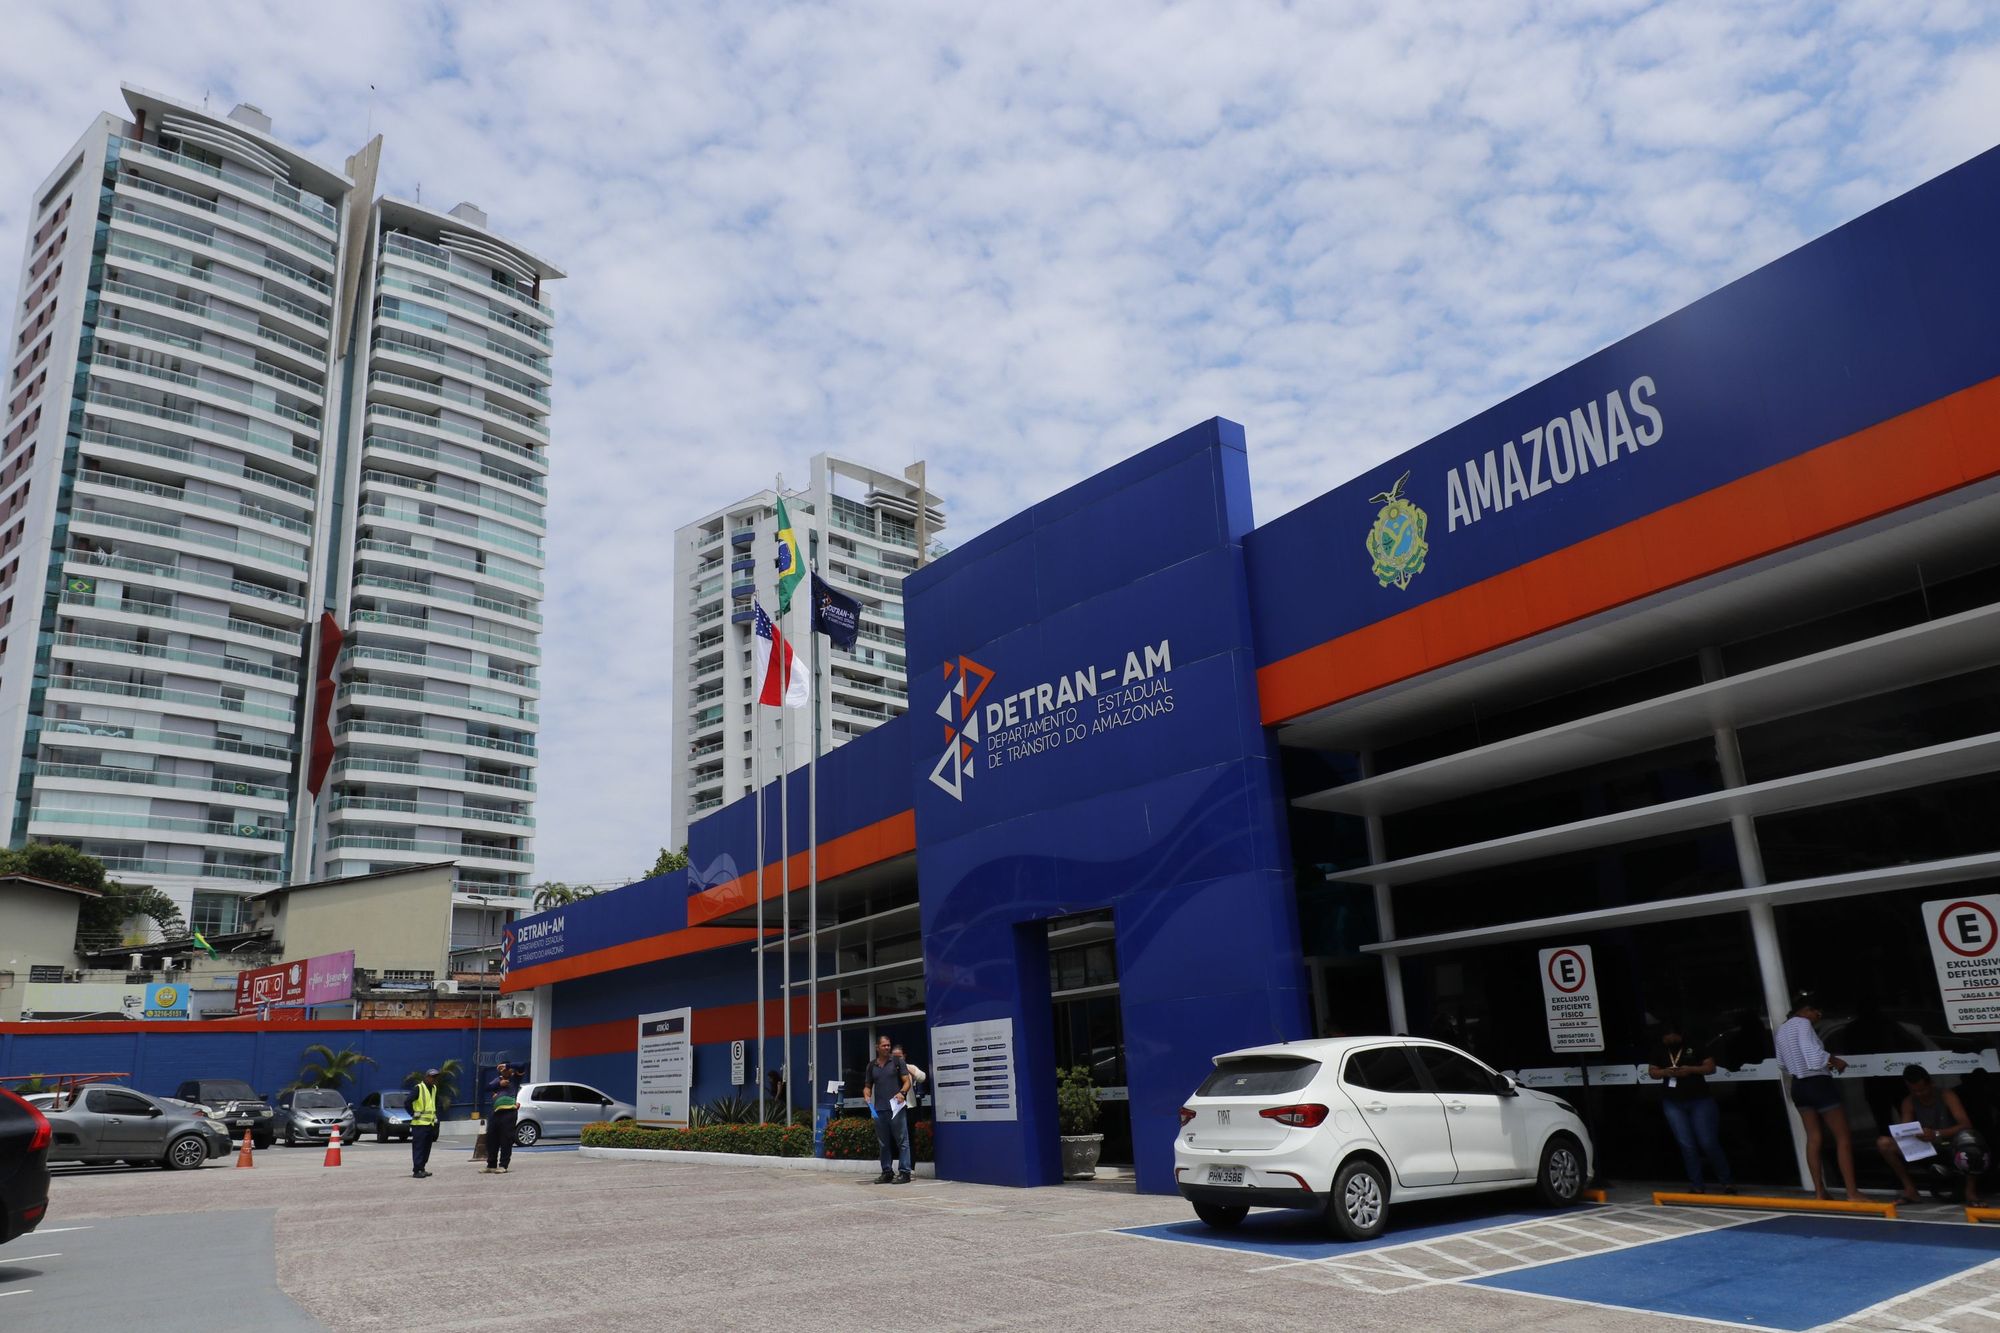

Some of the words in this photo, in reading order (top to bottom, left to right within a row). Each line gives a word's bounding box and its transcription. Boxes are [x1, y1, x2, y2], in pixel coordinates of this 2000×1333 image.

[1447, 375, 1664, 534] AMAZONAS
[986, 639, 1172, 734] DETRAN-AM
[987, 706, 1078, 751] DEPARTAMENTO
[1097, 676, 1174, 714] ESTADUAL
[988, 751, 1003, 769] DE
[1006, 731, 1061, 763] TRÂNSITO
[1065, 723, 1087, 744] DO
[1091, 695, 1175, 736] AMAZONAS
[517, 915, 565, 944] DETRAN-AM
[1956, 913, 1982, 944] E
[1560, 959, 1576, 983] E
[1946, 957, 2000, 969] EXCLUSIV
[1963, 978, 1999, 987] FÍSICO
[1551, 995, 1590, 1004] EXCLUSIVO
[1551, 1003, 1592, 1011] DEFICIENTE
[1561, 1010, 1584, 1018] FÍSICO
[735, 1045, 740, 1056] E
[1217, 1109, 1231, 1125] FIAT
